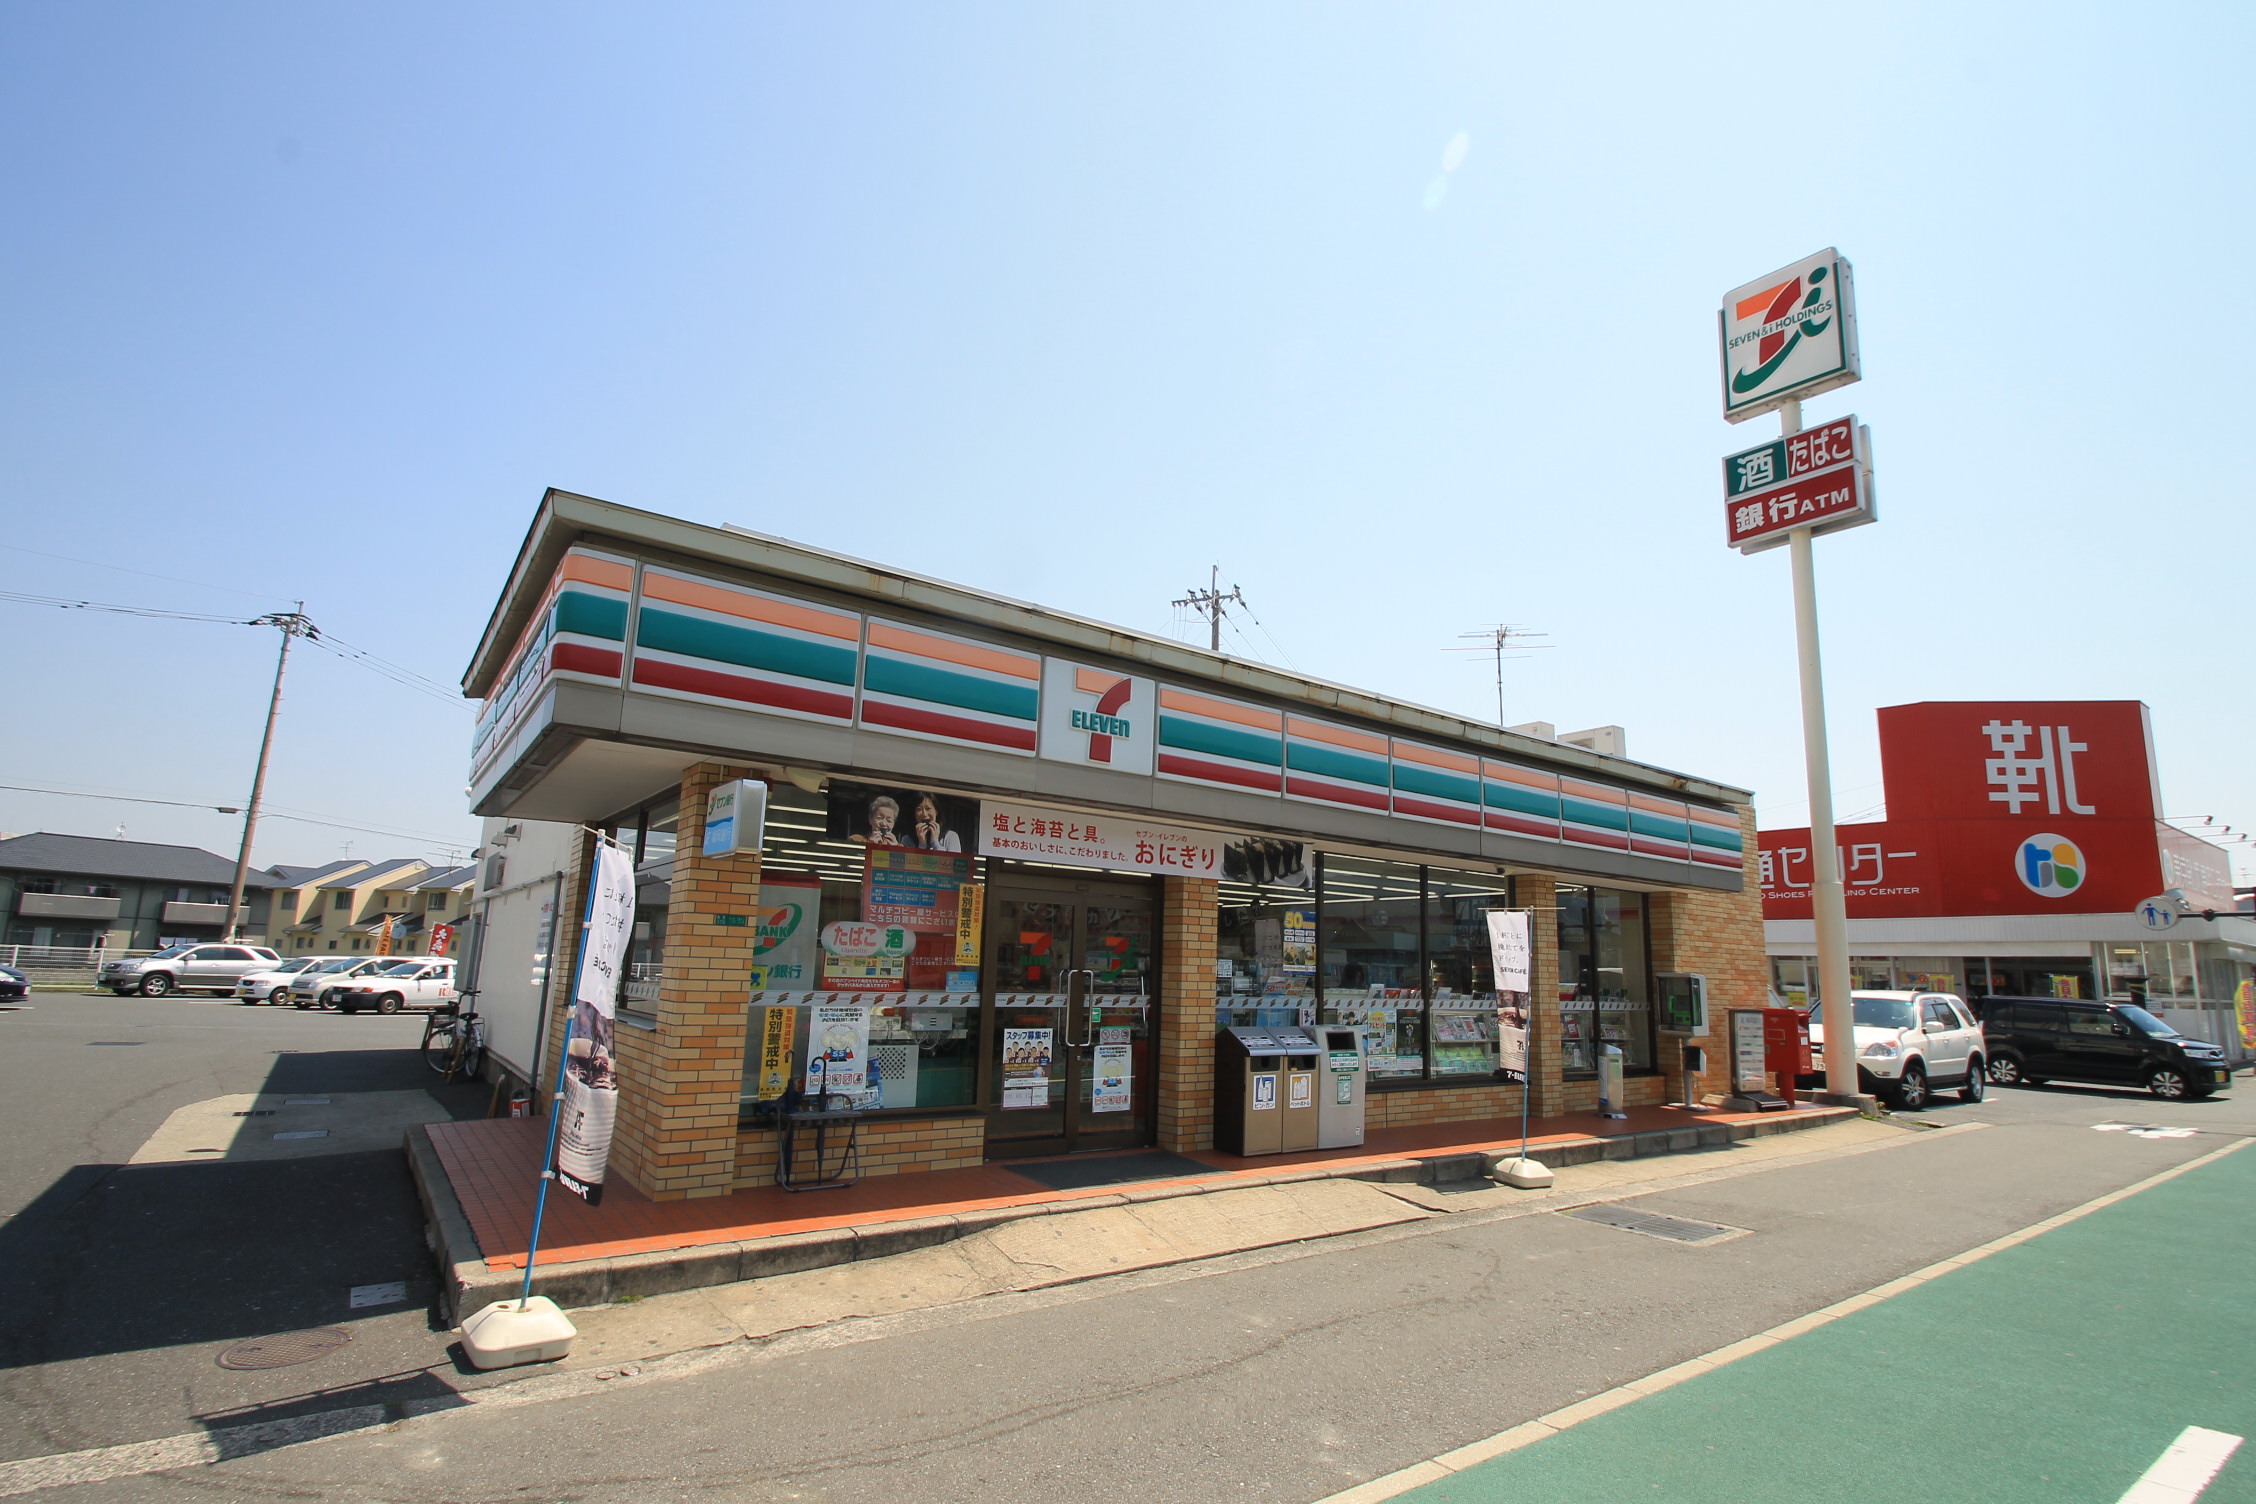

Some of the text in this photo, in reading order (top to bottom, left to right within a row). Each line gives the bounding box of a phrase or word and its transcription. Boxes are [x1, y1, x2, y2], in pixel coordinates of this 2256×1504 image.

[1775, 300, 1832, 331] HOLDINGS
[1789, 426, 1851, 475] たばこ
[1737, 448, 1774, 493] 酒
[1982, 719, 2096, 814] 靴
[992, 812, 1106, 844] 塩と海苔と具。
[992, 837, 1129, 862] 基本のおいしさに、こだわりました。
[1135, 840, 1216, 870] おにぎり
[1869, 887, 1920, 896] CENTER
[960, 887, 974, 940] 特別警戒中
[833, 926, 877, 947] たばこ
[885, 928, 904, 948] 酒
[765, 1008, 784, 1070] 特別警戒中
[1006, 1030, 1051, 1040] スタッフ募集中!
